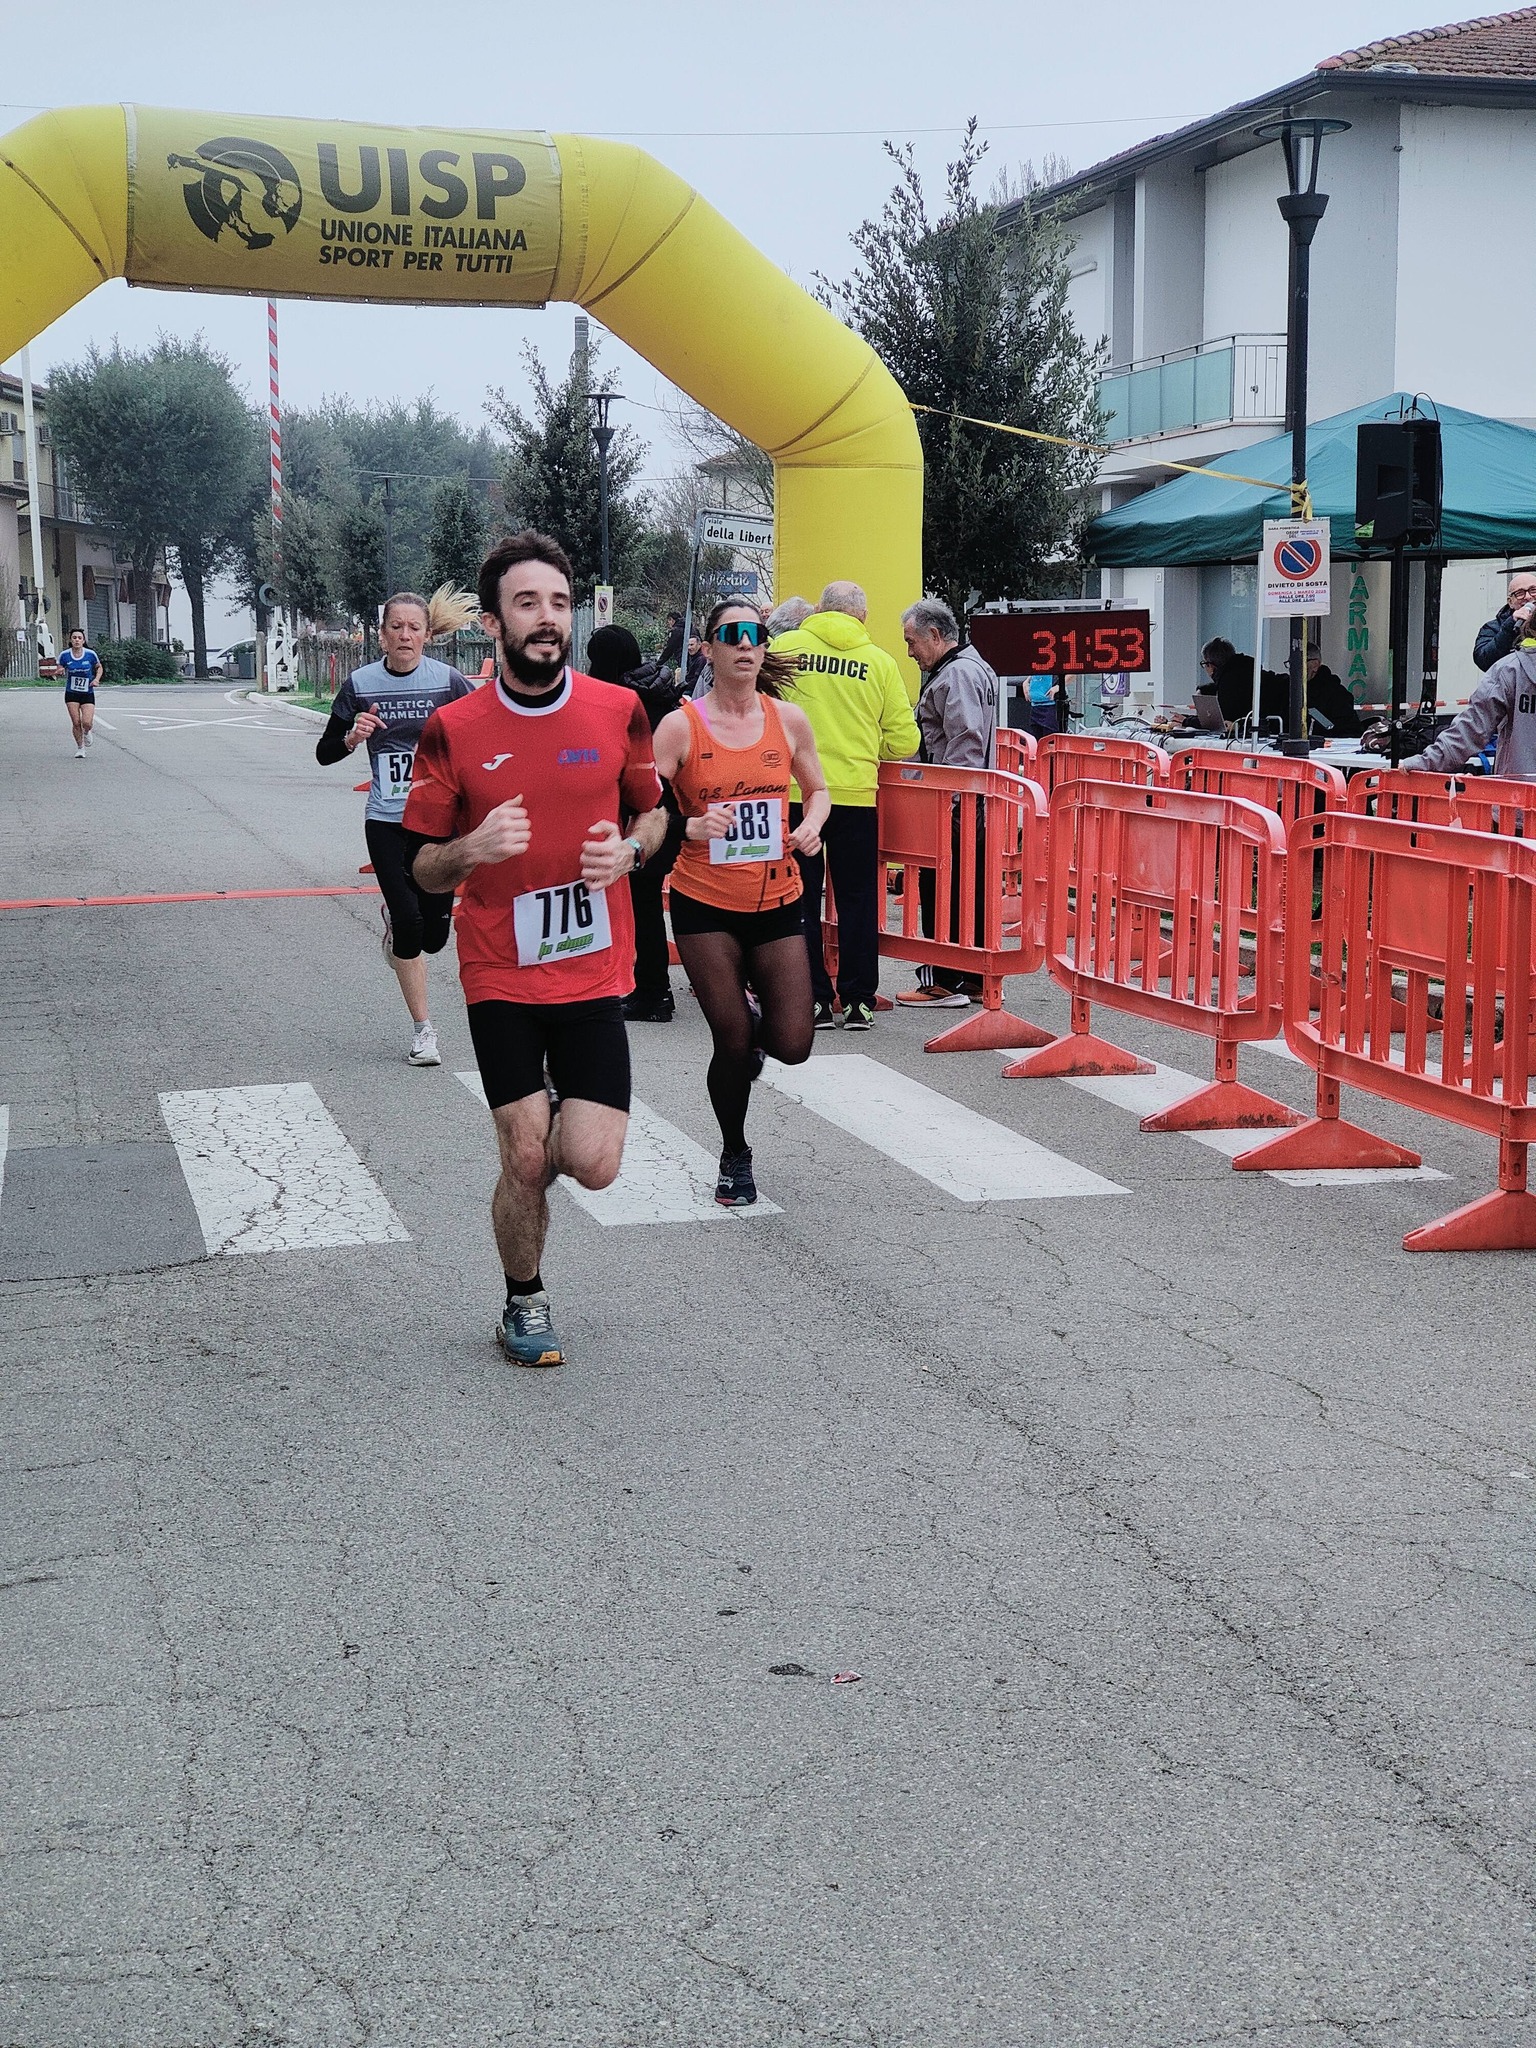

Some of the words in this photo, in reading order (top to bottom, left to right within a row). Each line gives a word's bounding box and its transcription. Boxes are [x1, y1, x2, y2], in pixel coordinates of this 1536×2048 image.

[317, 143, 526, 220] UISP
[320, 218, 413, 246] UNIONE
[424, 225, 528, 251] ITALIANA
[319, 245, 394, 269] SPORT
[403, 251, 443, 271] PER
[456, 253, 513, 274] TUTTI
[706, 526, 734, 541] della
[739, 529, 775, 546] Libert
[708, 518, 723, 526] viale
[1347, 561, 1370, 704] ARMAC
[1032, 628, 1145, 671] 31:53
[797, 652, 869, 681] GIUDICE
[74, 677, 87, 687] 627
[380, 710, 429, 720] MAMELI
[535, 881, 594, 939] 776
